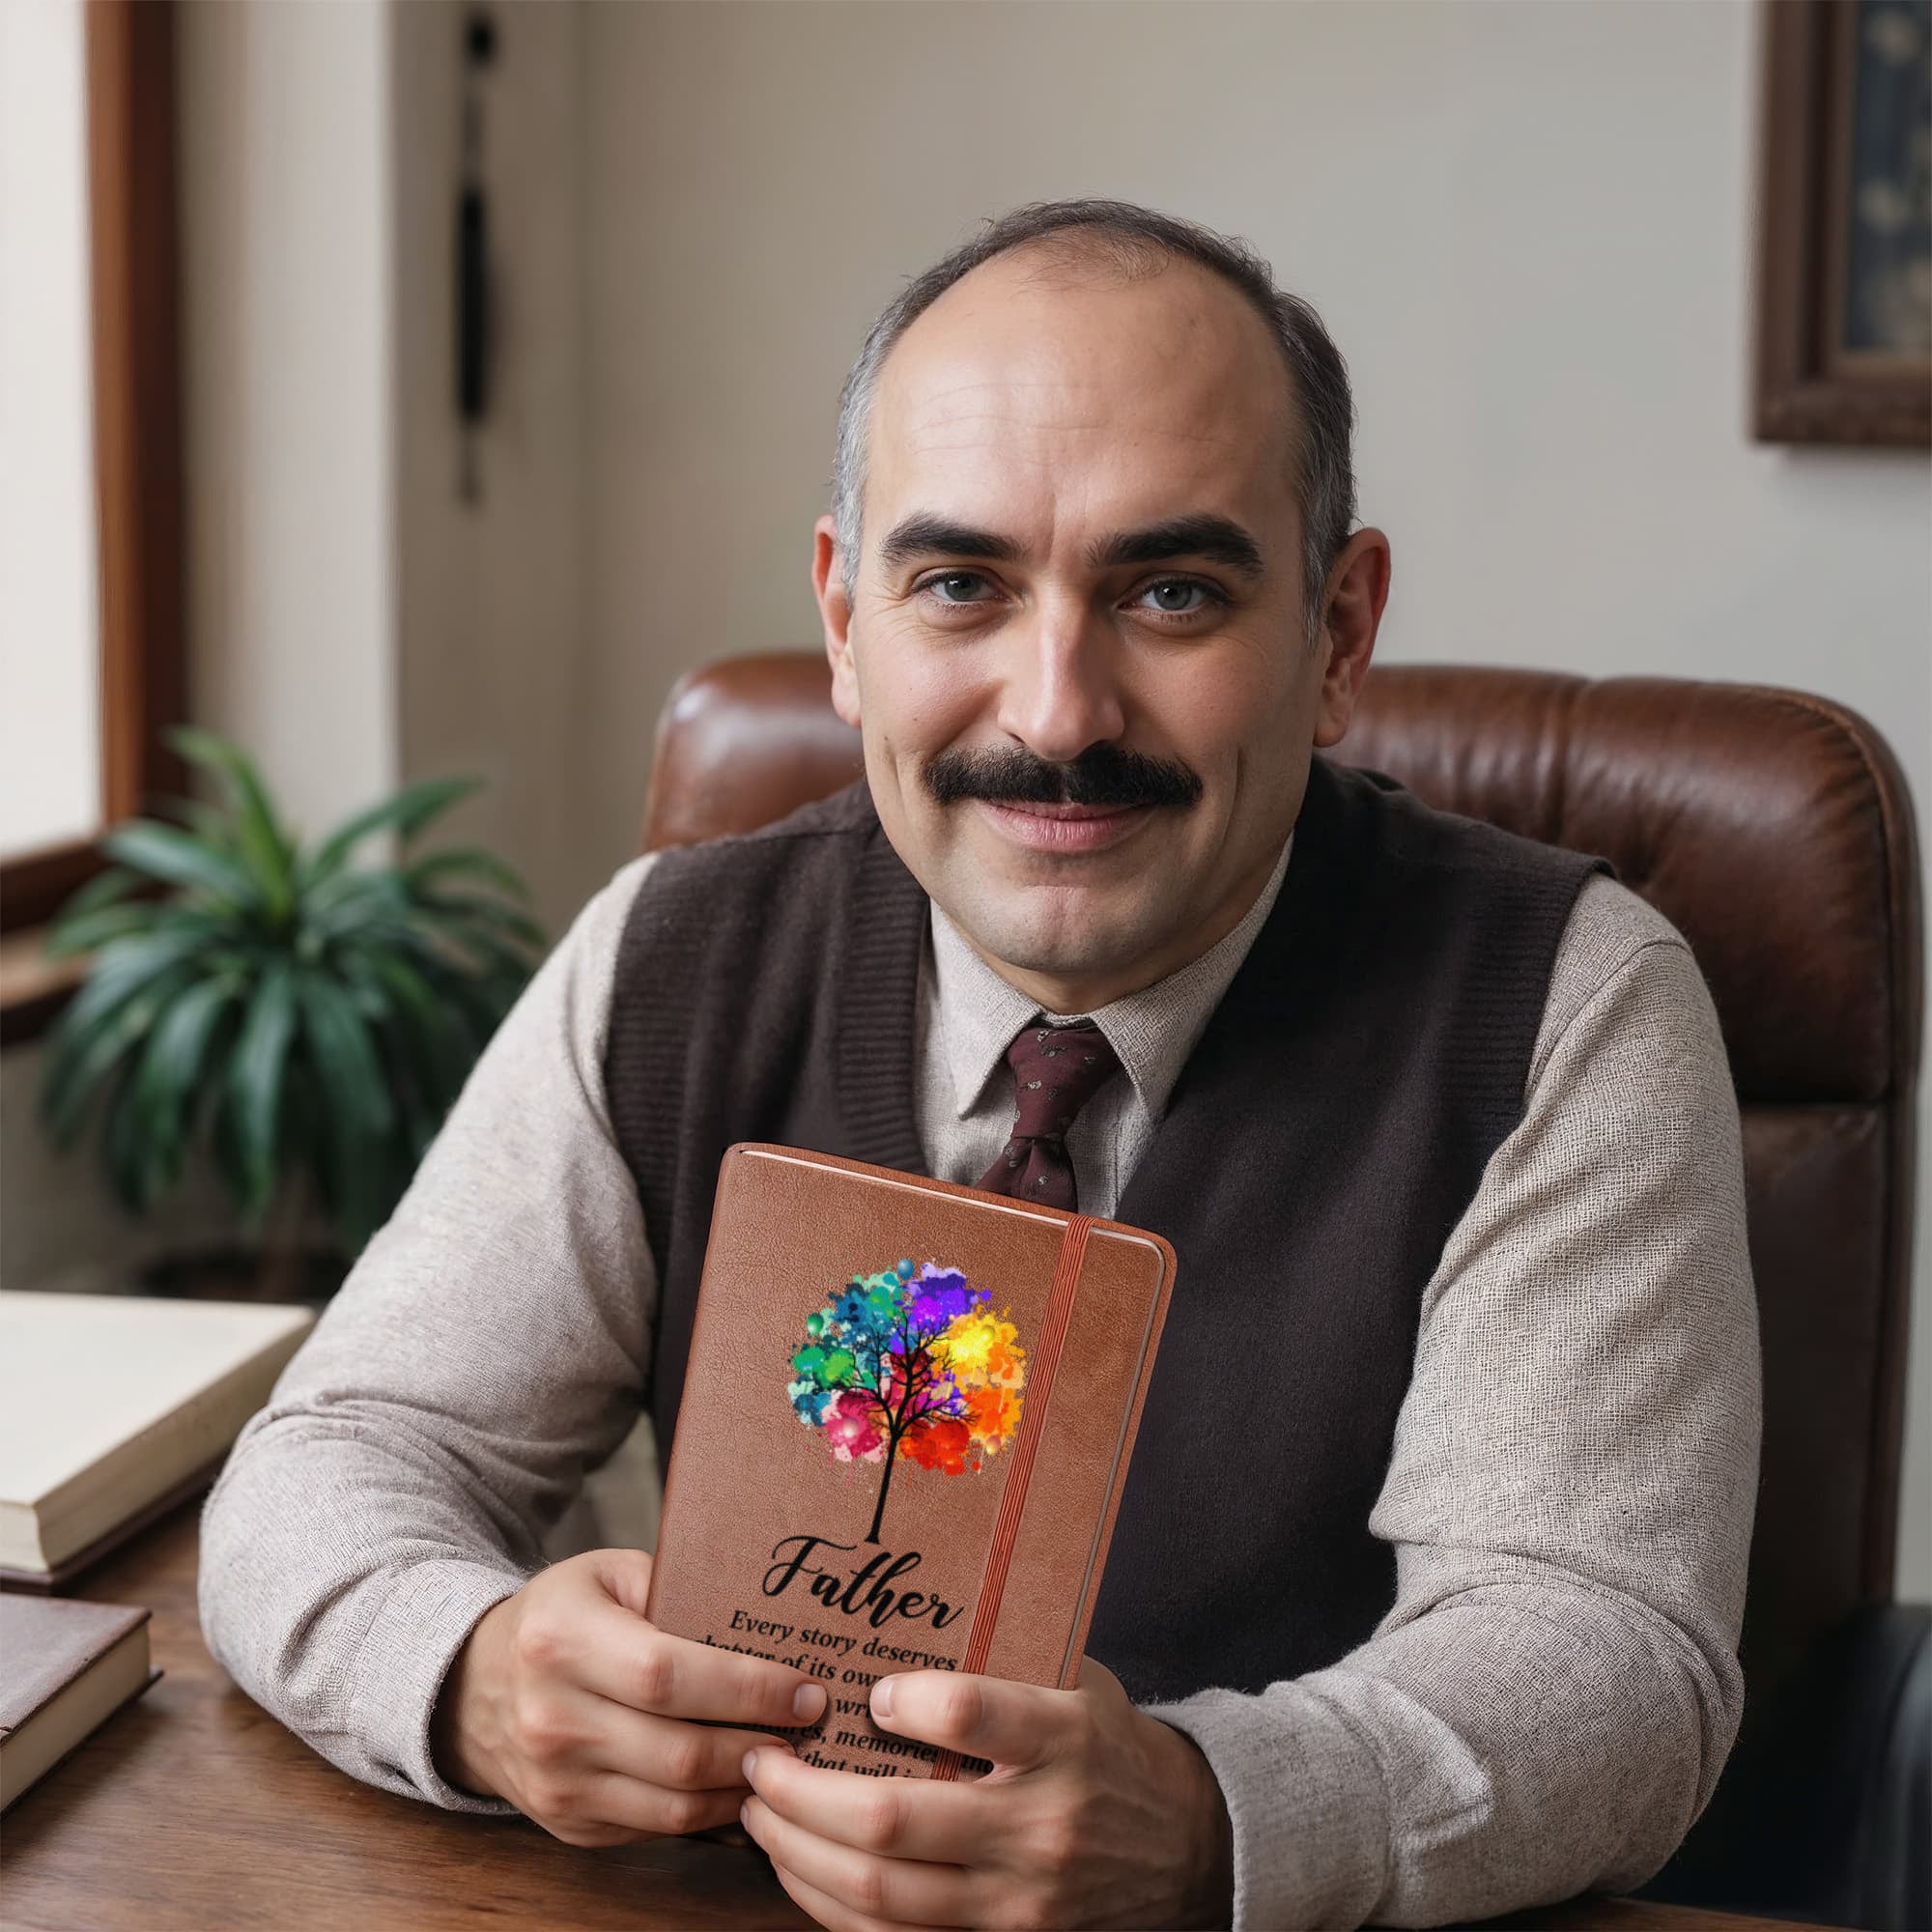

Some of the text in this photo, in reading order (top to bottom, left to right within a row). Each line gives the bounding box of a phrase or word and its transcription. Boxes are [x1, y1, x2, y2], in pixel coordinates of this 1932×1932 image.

[762, 1535, 965, 1630] Father
[729, 1609, 794, 1644] Every
[799, 1628, 857, 1657] story
[863, 1636, 957, 1672] deserves
[809, 1658, 837, 1680] its
[841, 1669, 884, 1688] ow
